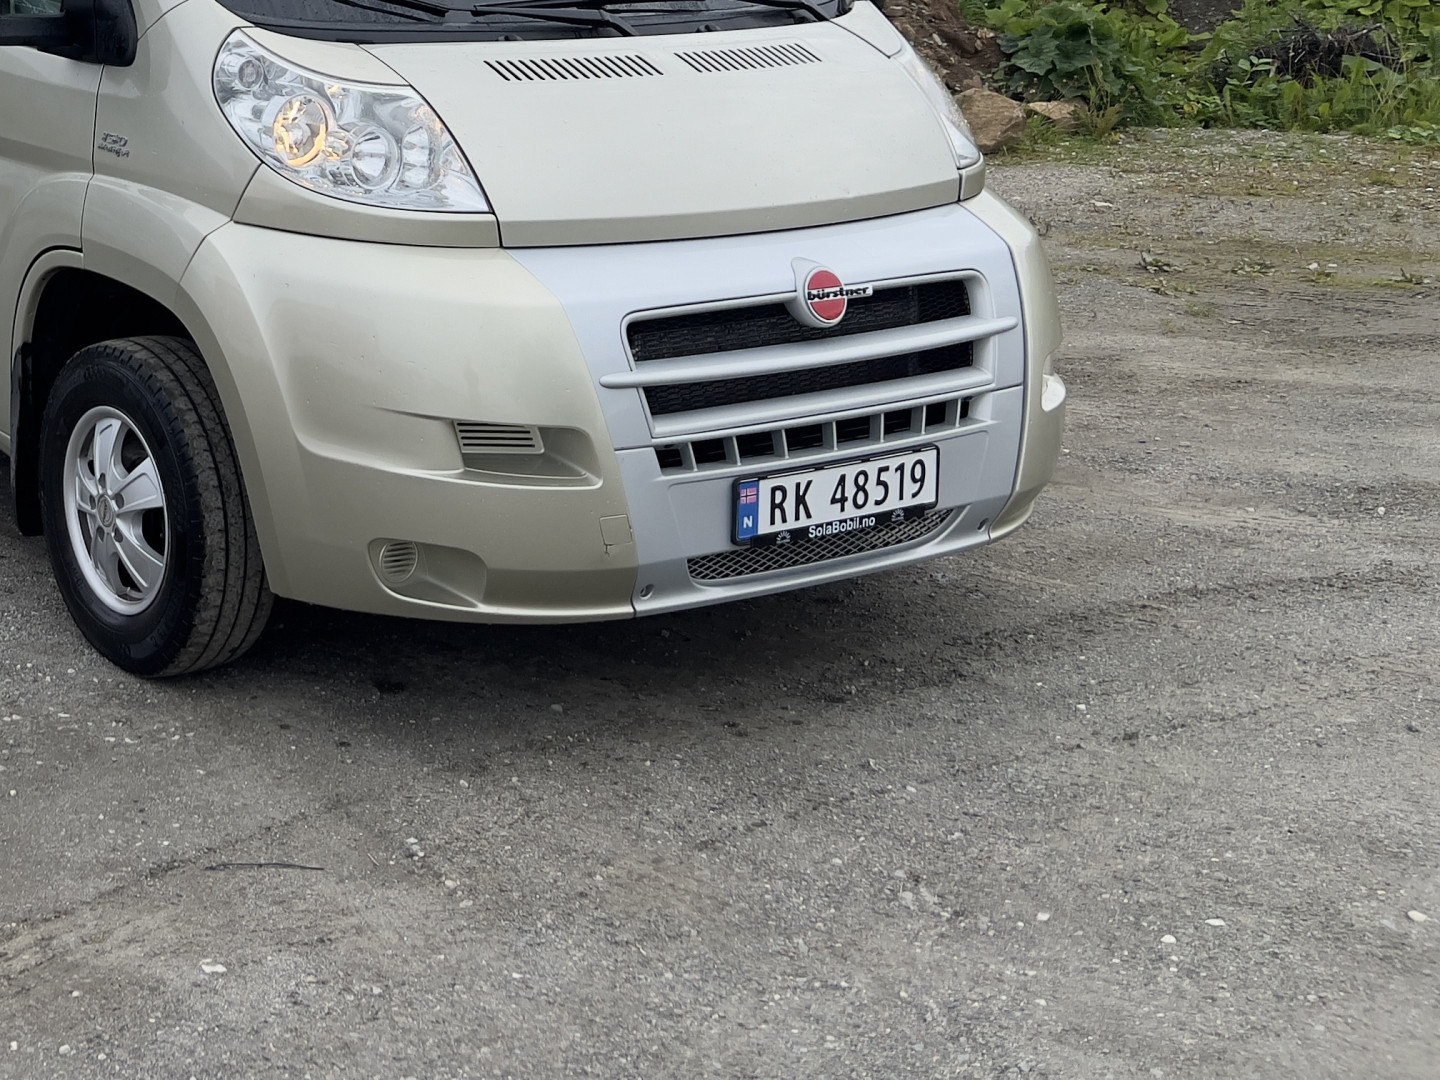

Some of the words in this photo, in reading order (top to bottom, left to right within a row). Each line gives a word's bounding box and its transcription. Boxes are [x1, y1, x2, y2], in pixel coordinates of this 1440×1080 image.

[806, 286, 870, 301] bürstner
[769, 478, 814, 526] RK
[829, 458, 927, 513] 48519
[742, 515, 754, 529] N
[807, 515, 877, 539] SolaBobil.no
